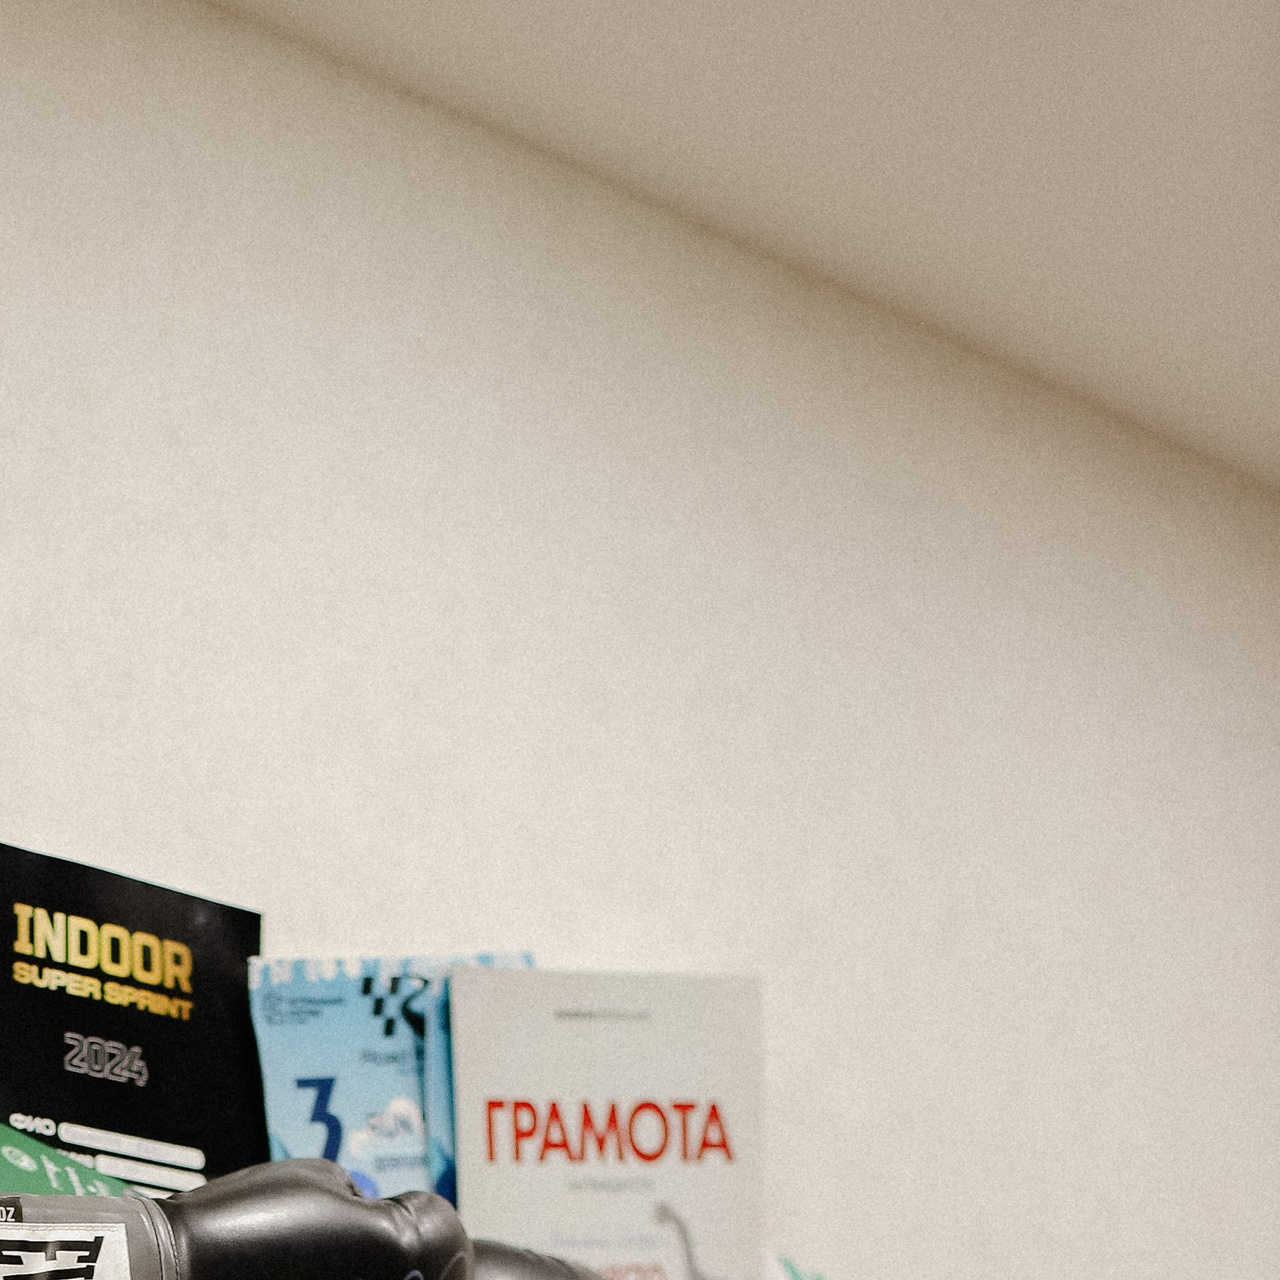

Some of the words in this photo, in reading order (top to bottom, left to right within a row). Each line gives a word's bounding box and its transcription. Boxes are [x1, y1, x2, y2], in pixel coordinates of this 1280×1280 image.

[13, 902, 194, 994] INDOOR
[12, 961, 102, 1001] SUPER
[102, 982, 195, 1021] SPRINT
[64, 1031, 149, 1088] 2024
[485, 1100, 733, 1162] ГРАМОТА
